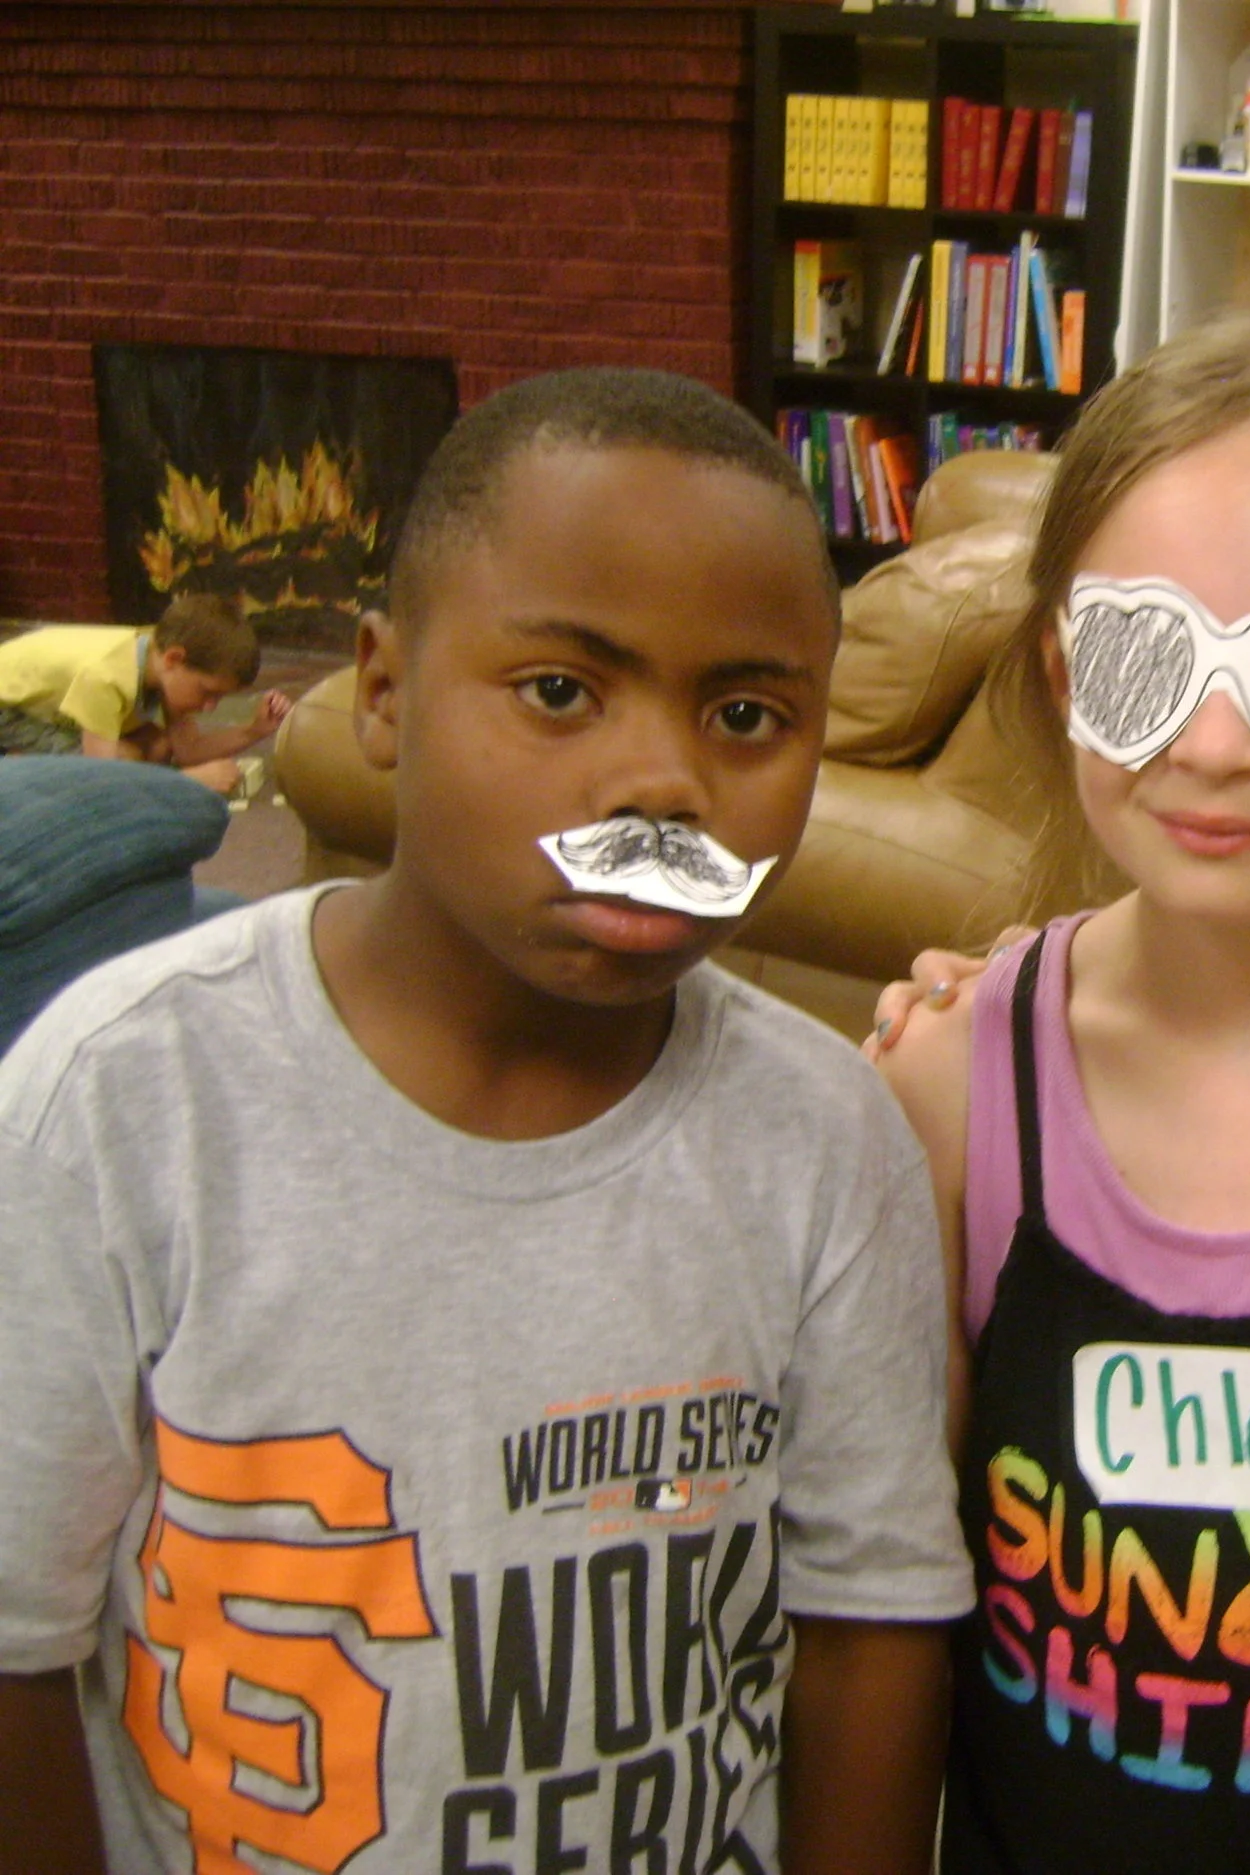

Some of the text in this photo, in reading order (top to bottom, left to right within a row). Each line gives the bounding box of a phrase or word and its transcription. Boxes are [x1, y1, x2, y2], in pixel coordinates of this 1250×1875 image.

[502, 1389, 781, 1516] WORLD SEES
[987, 1444, 1220, 1662] SUN
[450, 1500, 791, 1779] WOR
